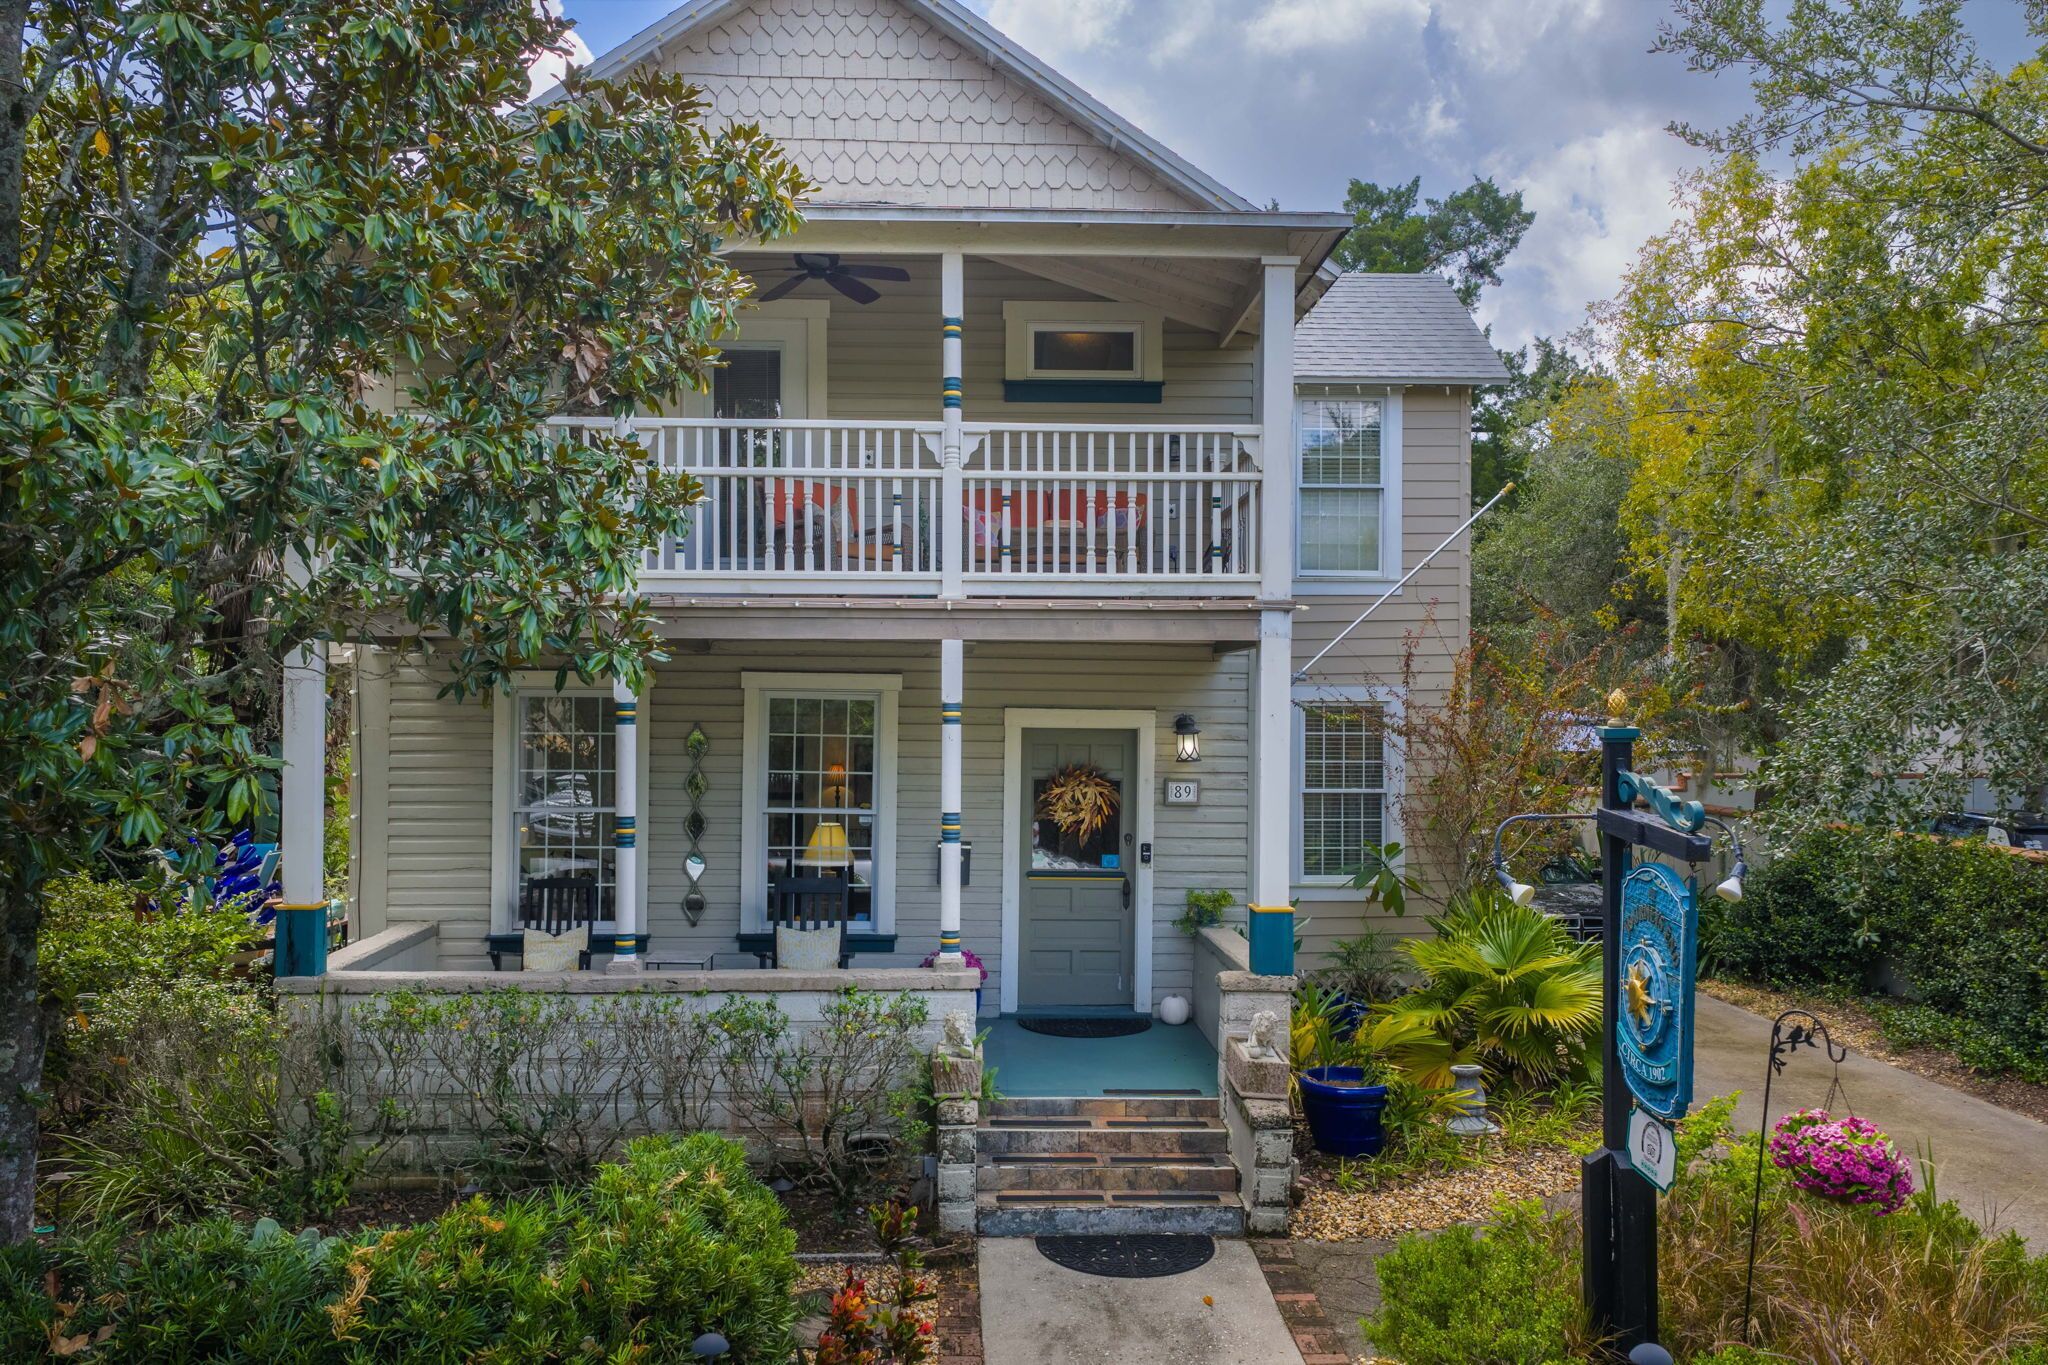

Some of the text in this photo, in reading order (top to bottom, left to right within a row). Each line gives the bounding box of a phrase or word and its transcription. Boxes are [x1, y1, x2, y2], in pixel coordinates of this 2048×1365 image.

[1174, 785, 1192, 799] 89
[1621, 1042, 1666, 1080] CIRCA 1902
